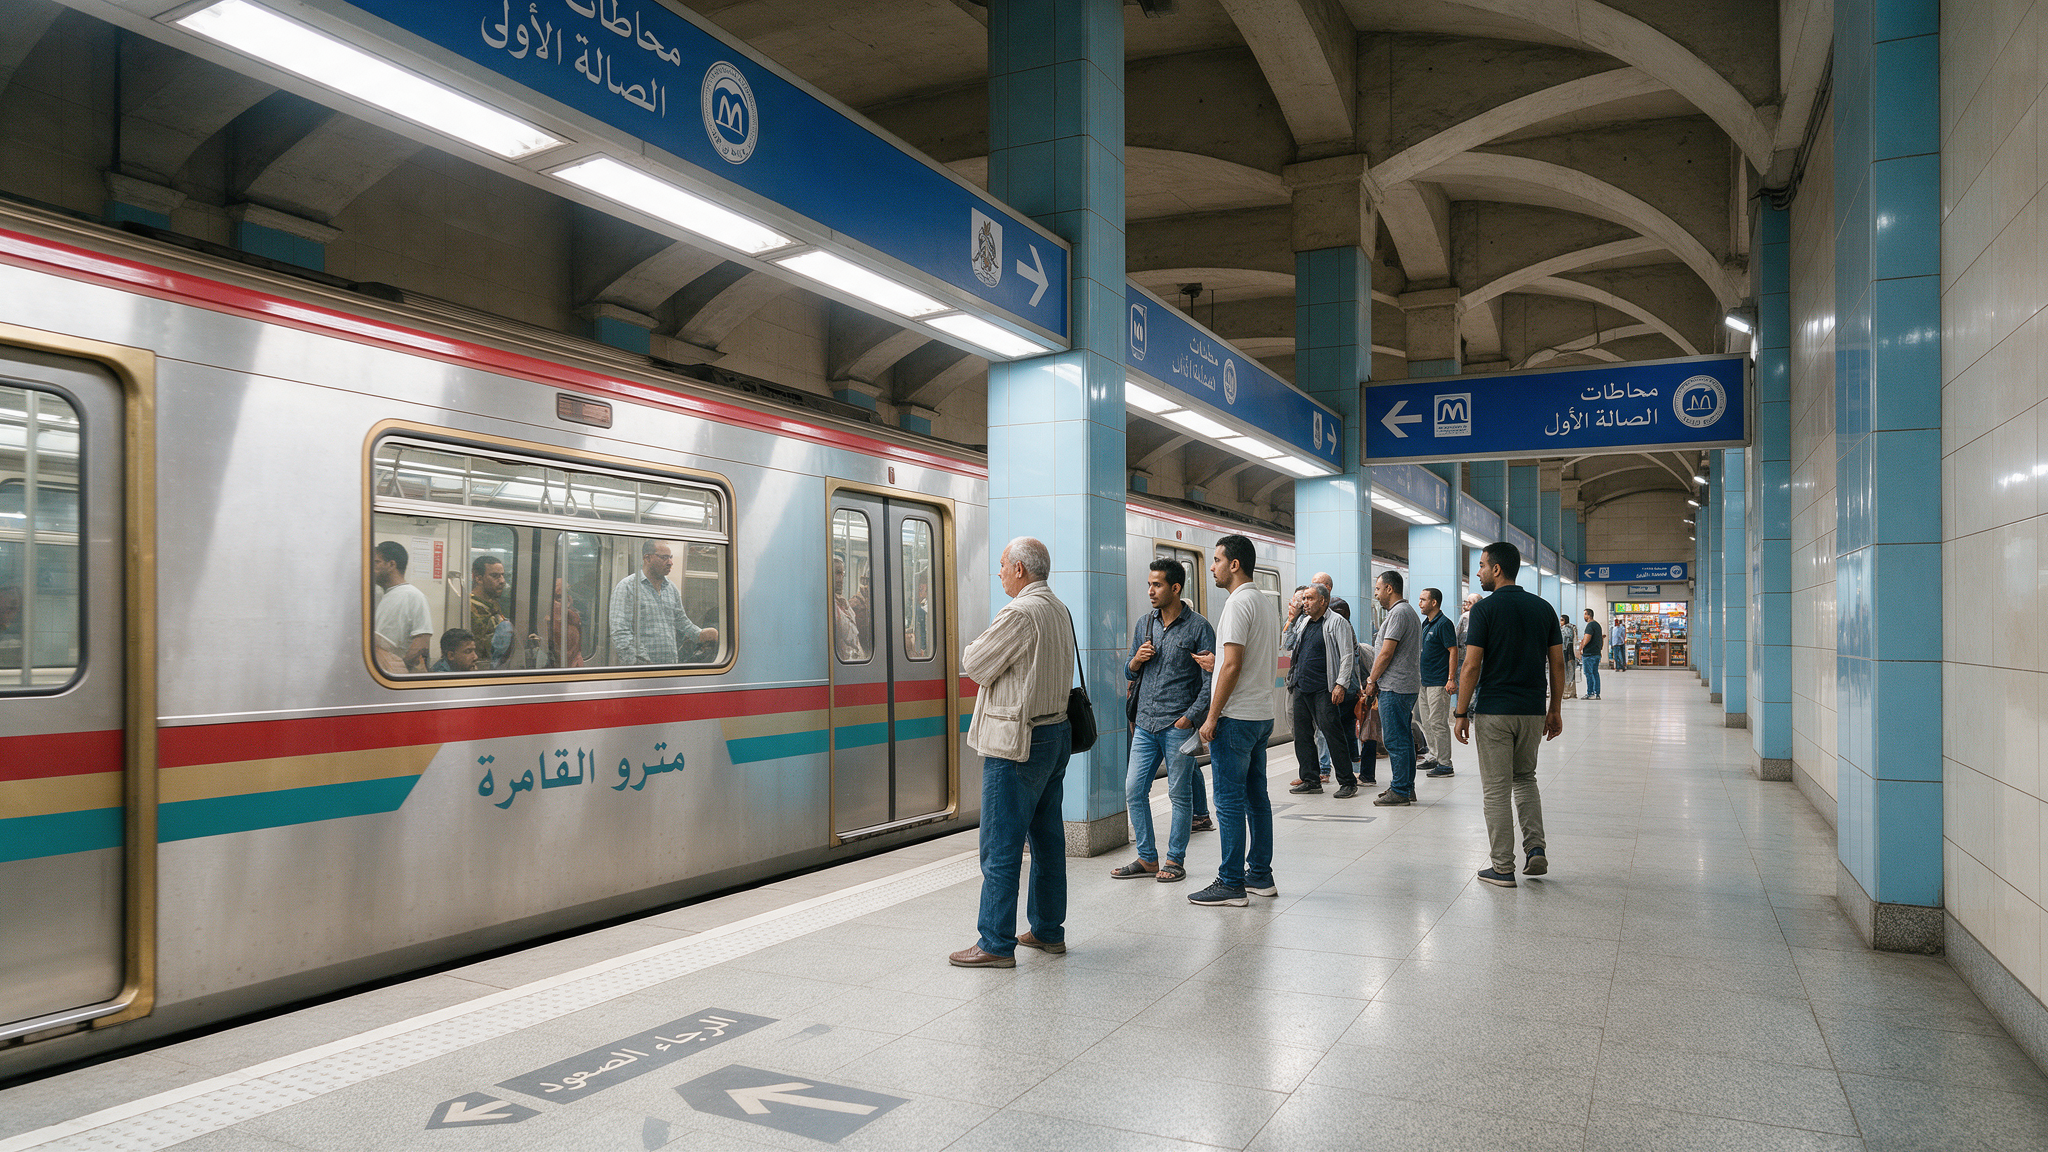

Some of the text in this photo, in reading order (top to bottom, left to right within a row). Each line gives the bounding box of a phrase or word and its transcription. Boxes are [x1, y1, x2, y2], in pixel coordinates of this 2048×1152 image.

[481, 0, 562, 65] الأولى
[574, 33, 666, 119] الصالة
[1544, 406, 1658, 436] الصالة الأول
[1580, 382, 1659, 401] محاطات
[477, 741, 685, 810] مترو القامرة
[539, 1015, 738, 1093] الرجاء الصعود
